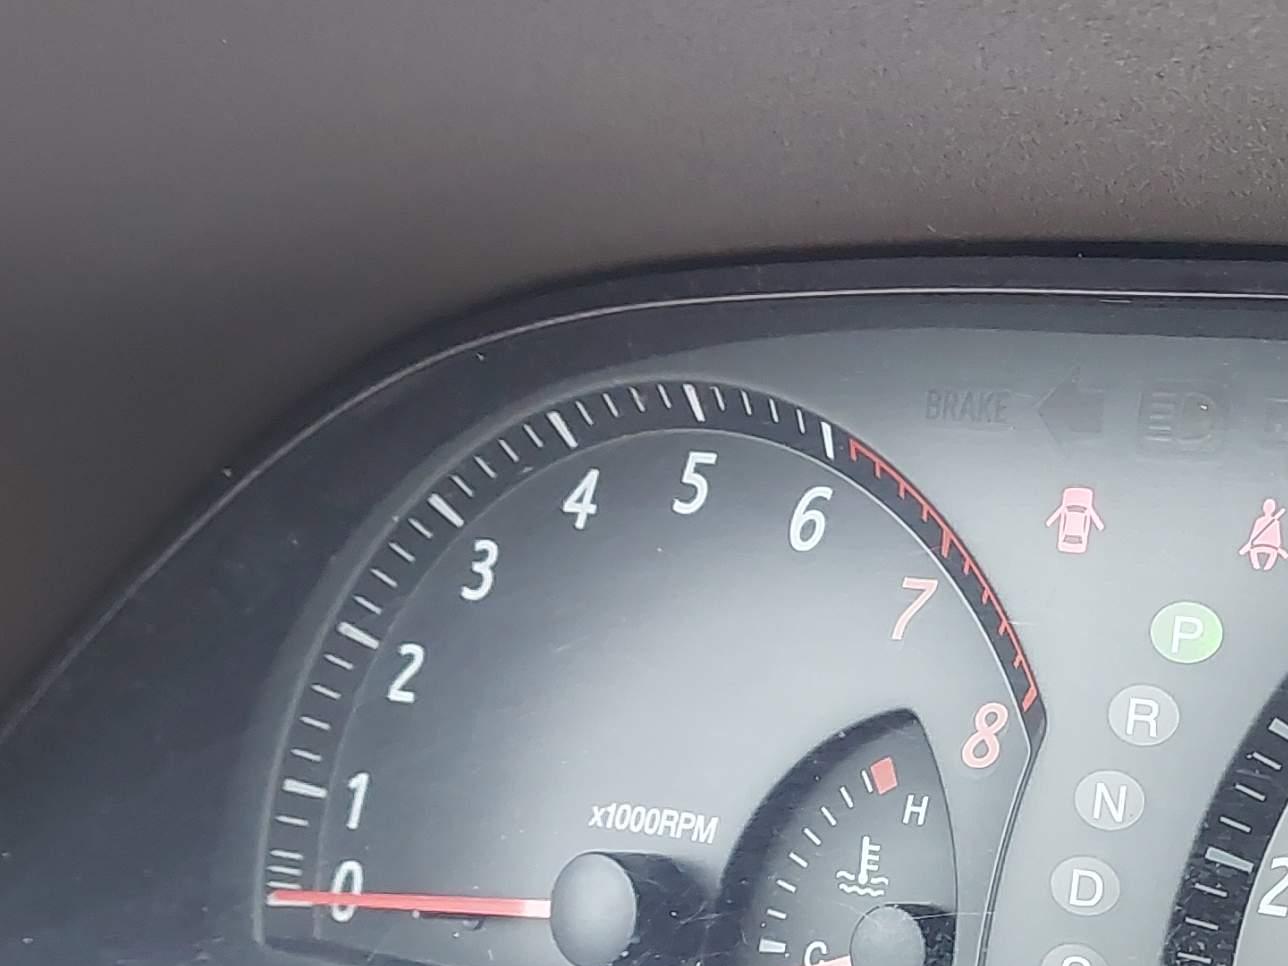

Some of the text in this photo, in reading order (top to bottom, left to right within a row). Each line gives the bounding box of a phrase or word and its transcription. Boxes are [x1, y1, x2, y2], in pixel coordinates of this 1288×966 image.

[925, 388, 1007, 424] BRAKE
[563, 467, 600, 530] 4
[673, 452, 717, 515] 5
[789, 486, 833, 552] 6
[461, 540, 498, 602] 3
[890, 577, 938, 641] 7
[1169, 616, 1204, 655] P
[387, 643, 425, 704] 2
[960, 701, 1009, 769] 8
[1125, 697, 1162, 738] R
[347, 773, 370, 829] 1
[588, 805, 719, 845] x1000RPM
[903, 794, 929, 826] H
[1092, 782, 1128, 822] N
[331, 860, 363, 922] 0
[1068, 867, 1103, 907] D
